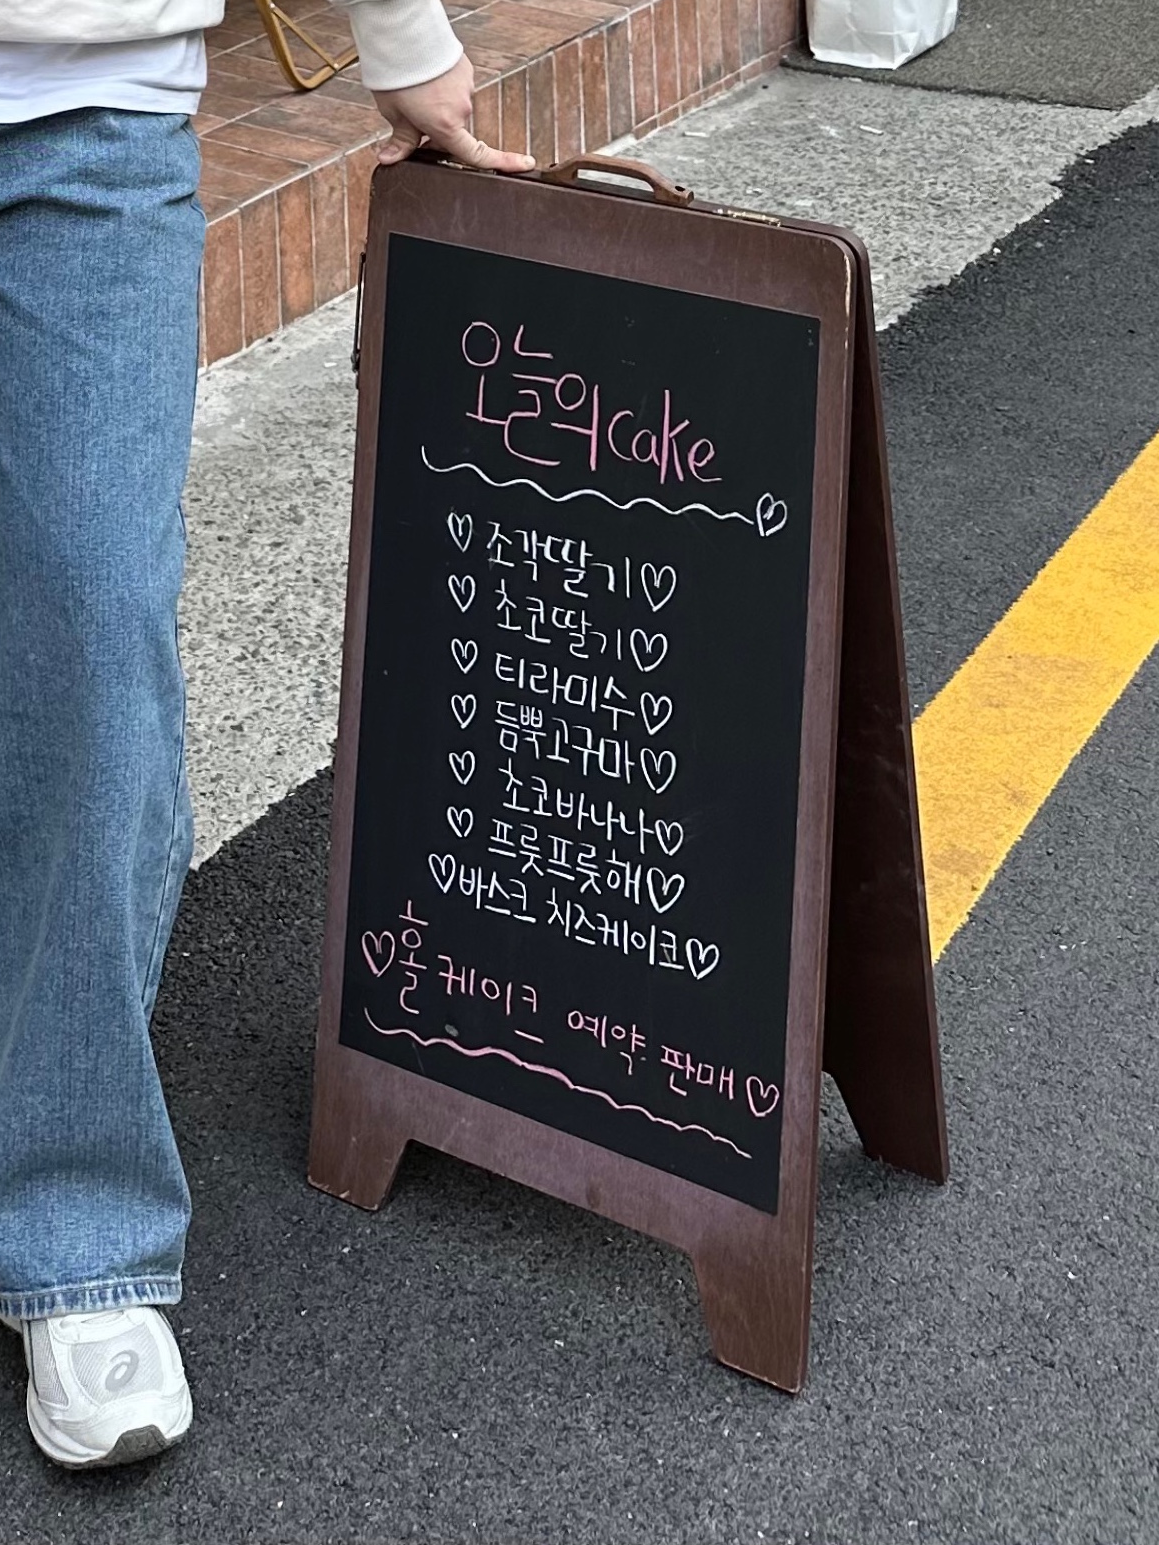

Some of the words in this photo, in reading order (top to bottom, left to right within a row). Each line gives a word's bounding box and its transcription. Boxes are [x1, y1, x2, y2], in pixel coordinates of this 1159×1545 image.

[486, 519, 631, 599] 조각딸기
[494, 578, 623, 660] 초코딸기
[495, 652, 636, 732] 티라미수
[498, 757, 655, 855] 초코바나나
[459, 864, 537, 924] 바스크
[546, 887, 685, 970] 치즈케이크
[567, 1010, 647, 1076] 예약
[660, 1045, 736, 1100] 판매
